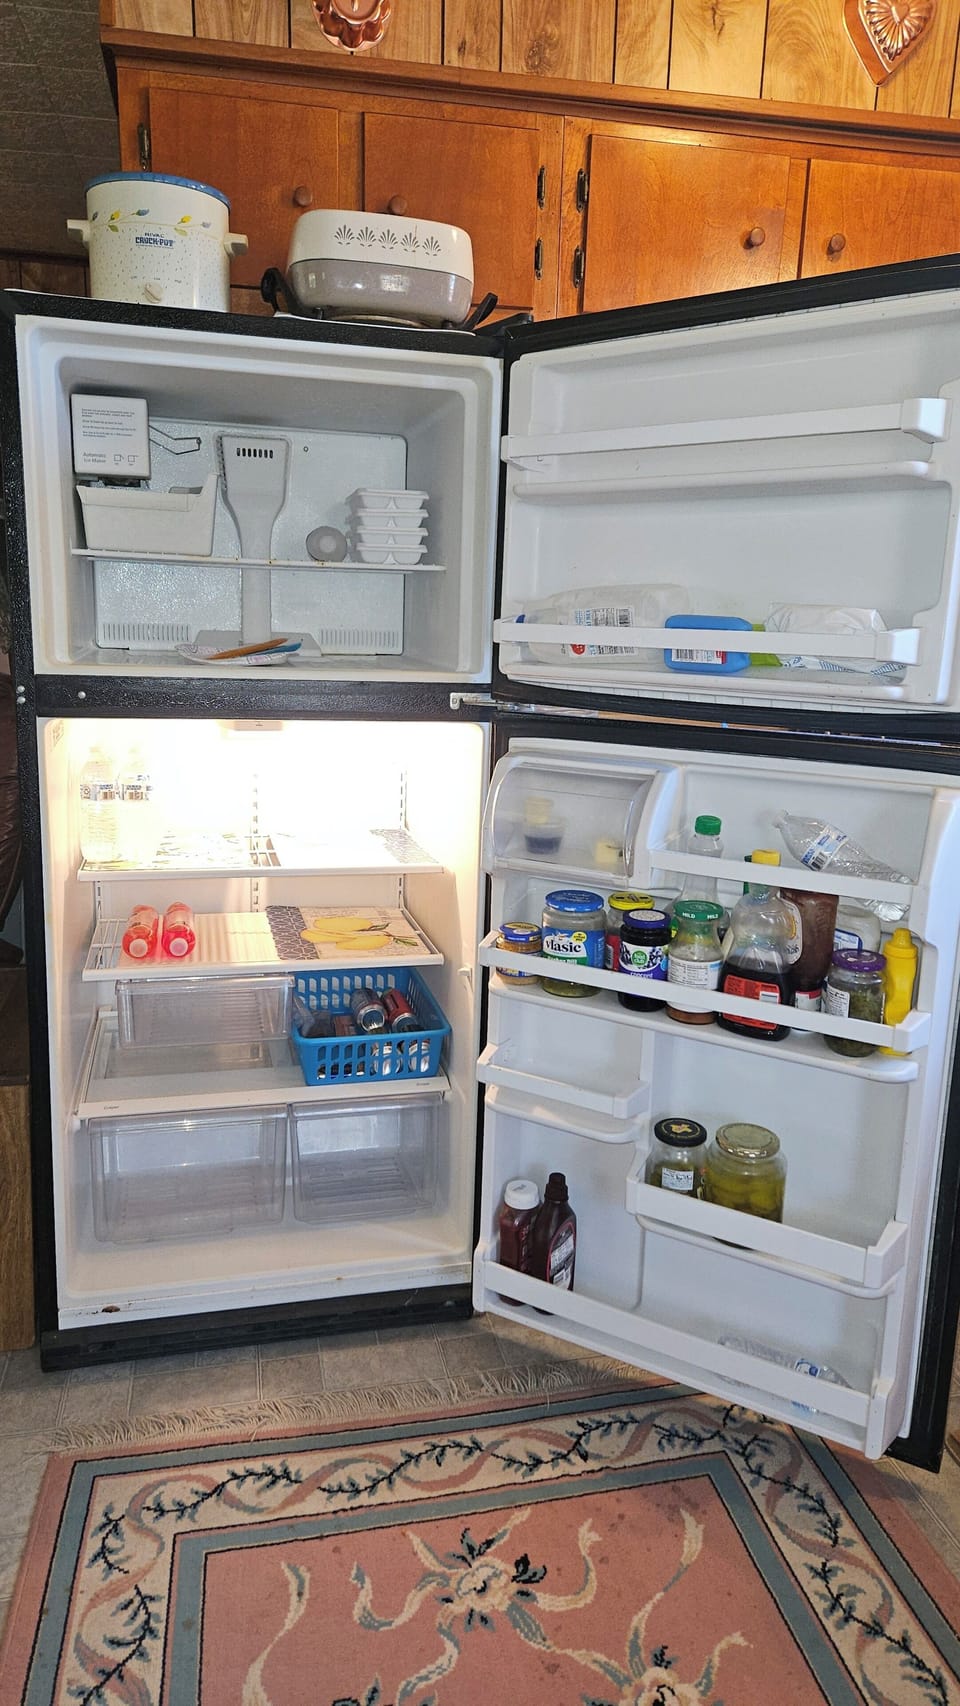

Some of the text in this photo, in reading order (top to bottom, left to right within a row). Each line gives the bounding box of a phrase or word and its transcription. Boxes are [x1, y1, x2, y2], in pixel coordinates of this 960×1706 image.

[135, 236, 173, 246] CROCK-POT
[682, 911, 696, 919] MILD
[546, 939, 582, 953] Vlasic
